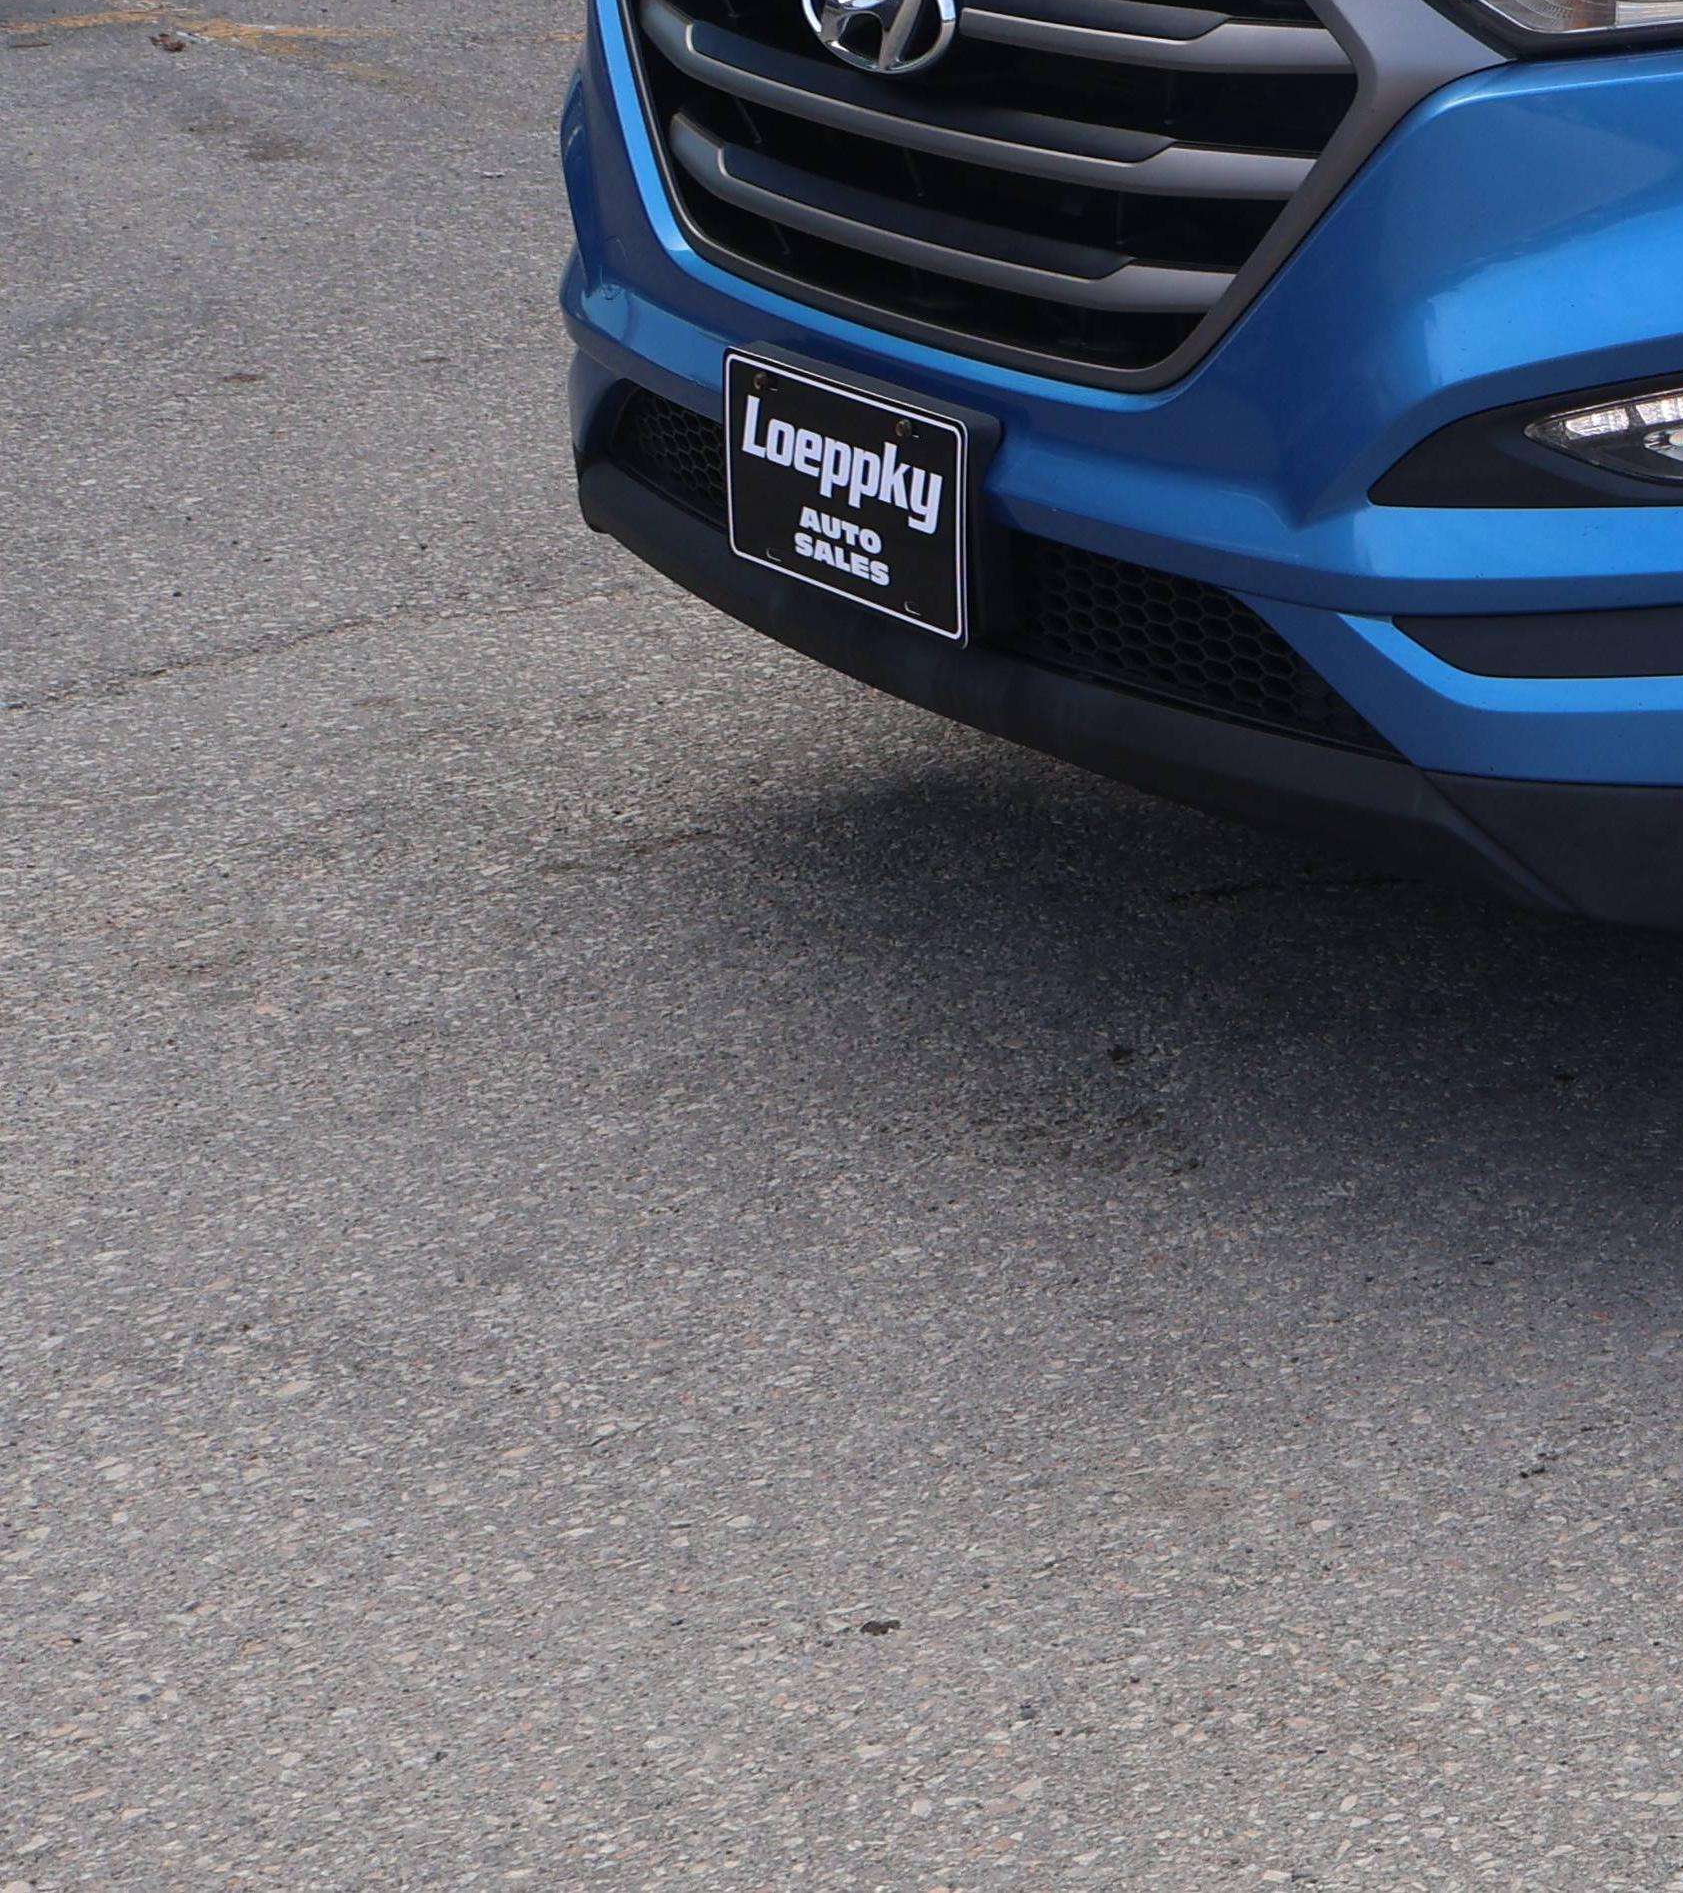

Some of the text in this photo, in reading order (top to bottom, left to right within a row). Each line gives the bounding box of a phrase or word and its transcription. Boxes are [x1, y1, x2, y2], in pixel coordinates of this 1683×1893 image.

[742, 395, 942, 535] Loeppky
[800, 507, 882, 554] AUTO
[795, 533, 890, 586] SALES
